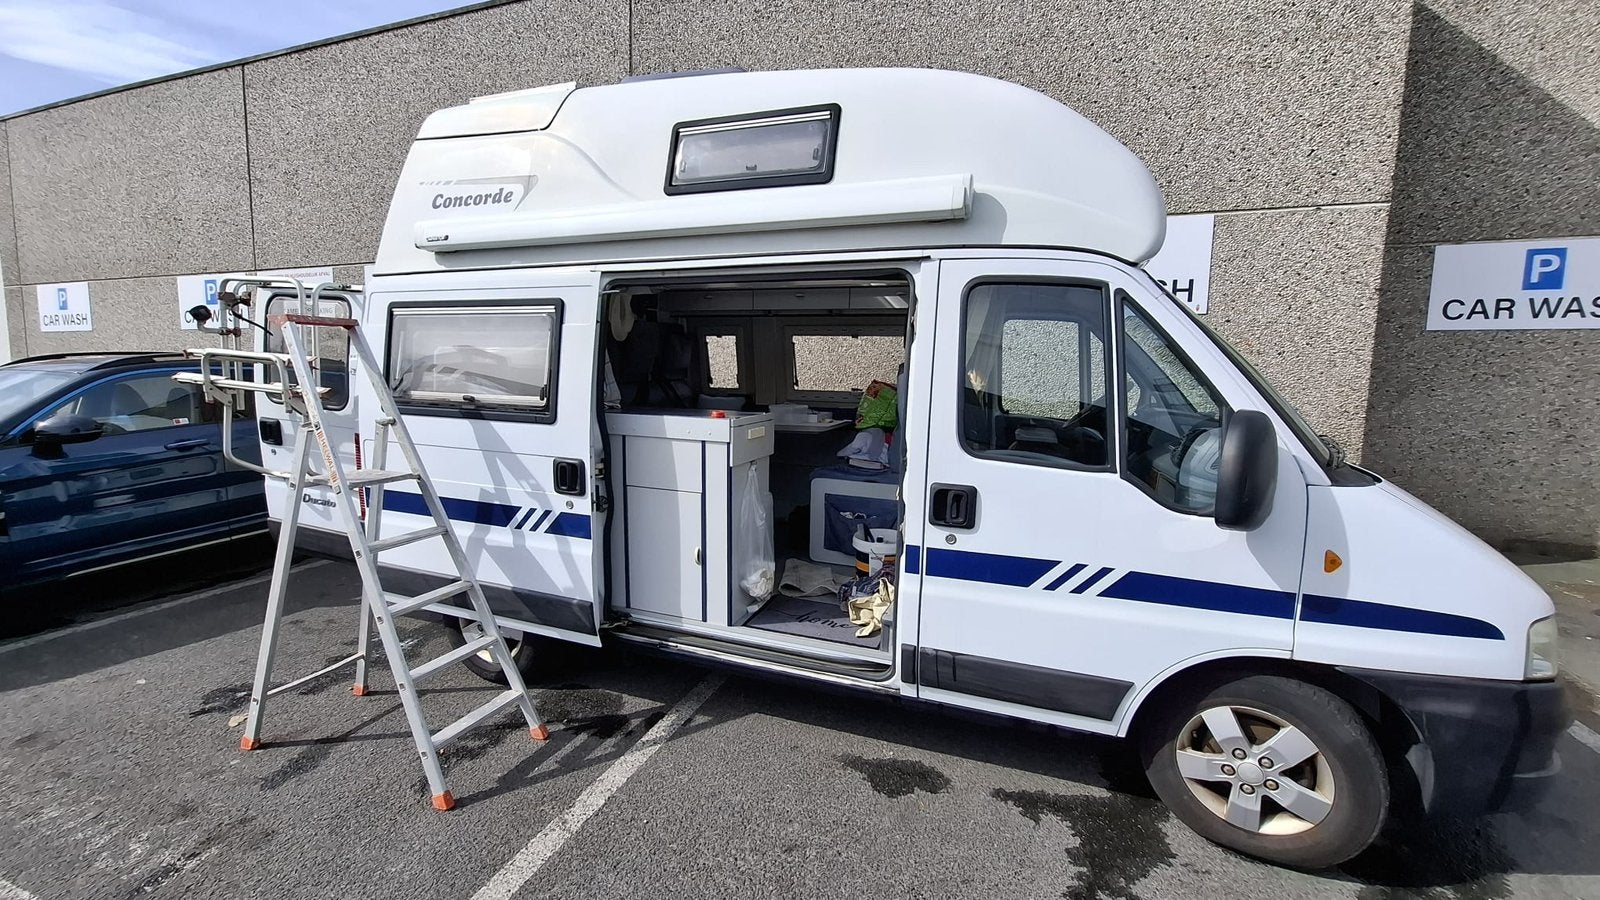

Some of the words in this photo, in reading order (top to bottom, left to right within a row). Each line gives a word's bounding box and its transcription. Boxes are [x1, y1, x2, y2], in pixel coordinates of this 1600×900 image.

[432, 187, 514, 209] Concorde
[1530, 253, 1561, 284] P
[43, 314, 60, 327] CAR
[61, 313, 88, 326] WASH
[1442, 298, 1516, 320] CAR
[303, 494, 336, 508] Ducato
